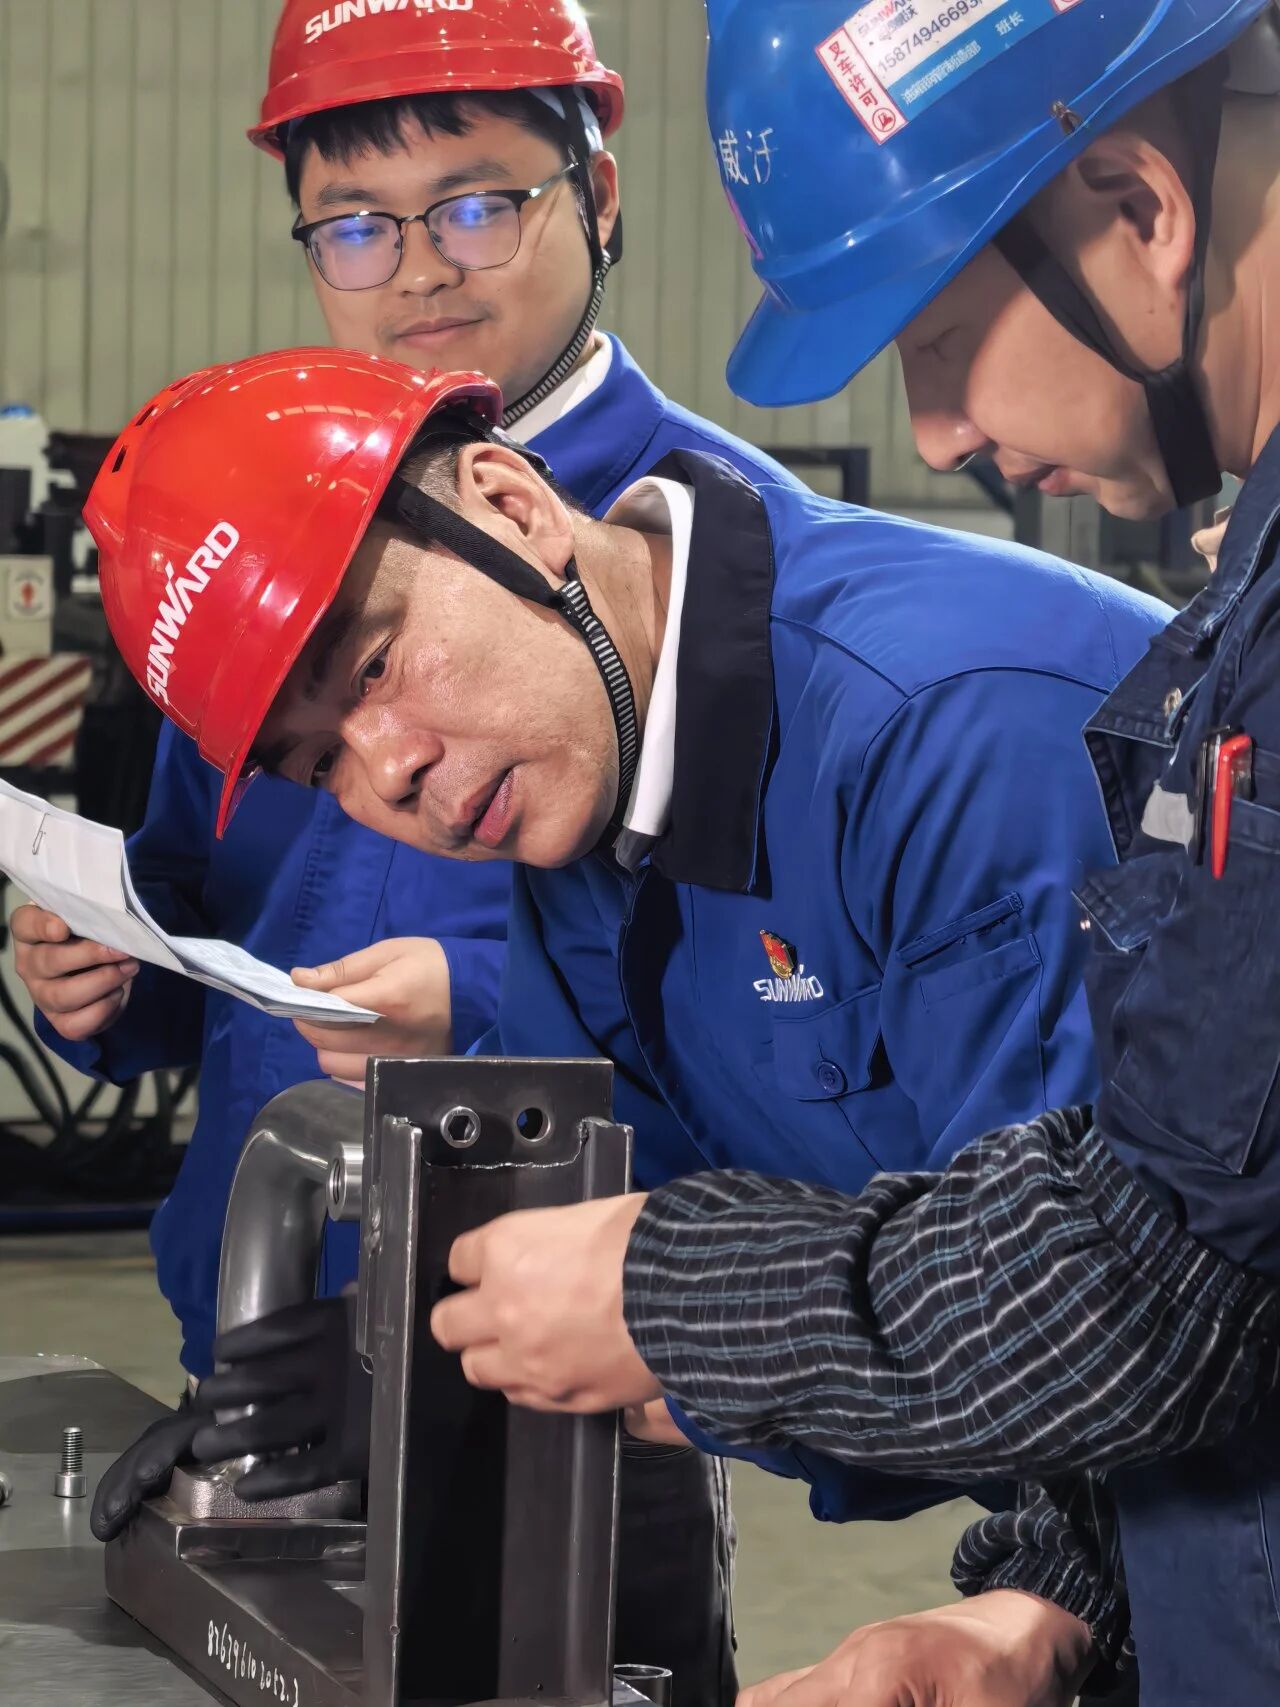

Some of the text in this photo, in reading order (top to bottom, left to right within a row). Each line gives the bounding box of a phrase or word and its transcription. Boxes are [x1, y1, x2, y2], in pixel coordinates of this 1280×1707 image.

[994, 11, 1026, 36] 班长
[828, 40, 878, 107] 叉车许可
[146, 521, 240, 705] SUNWARD
